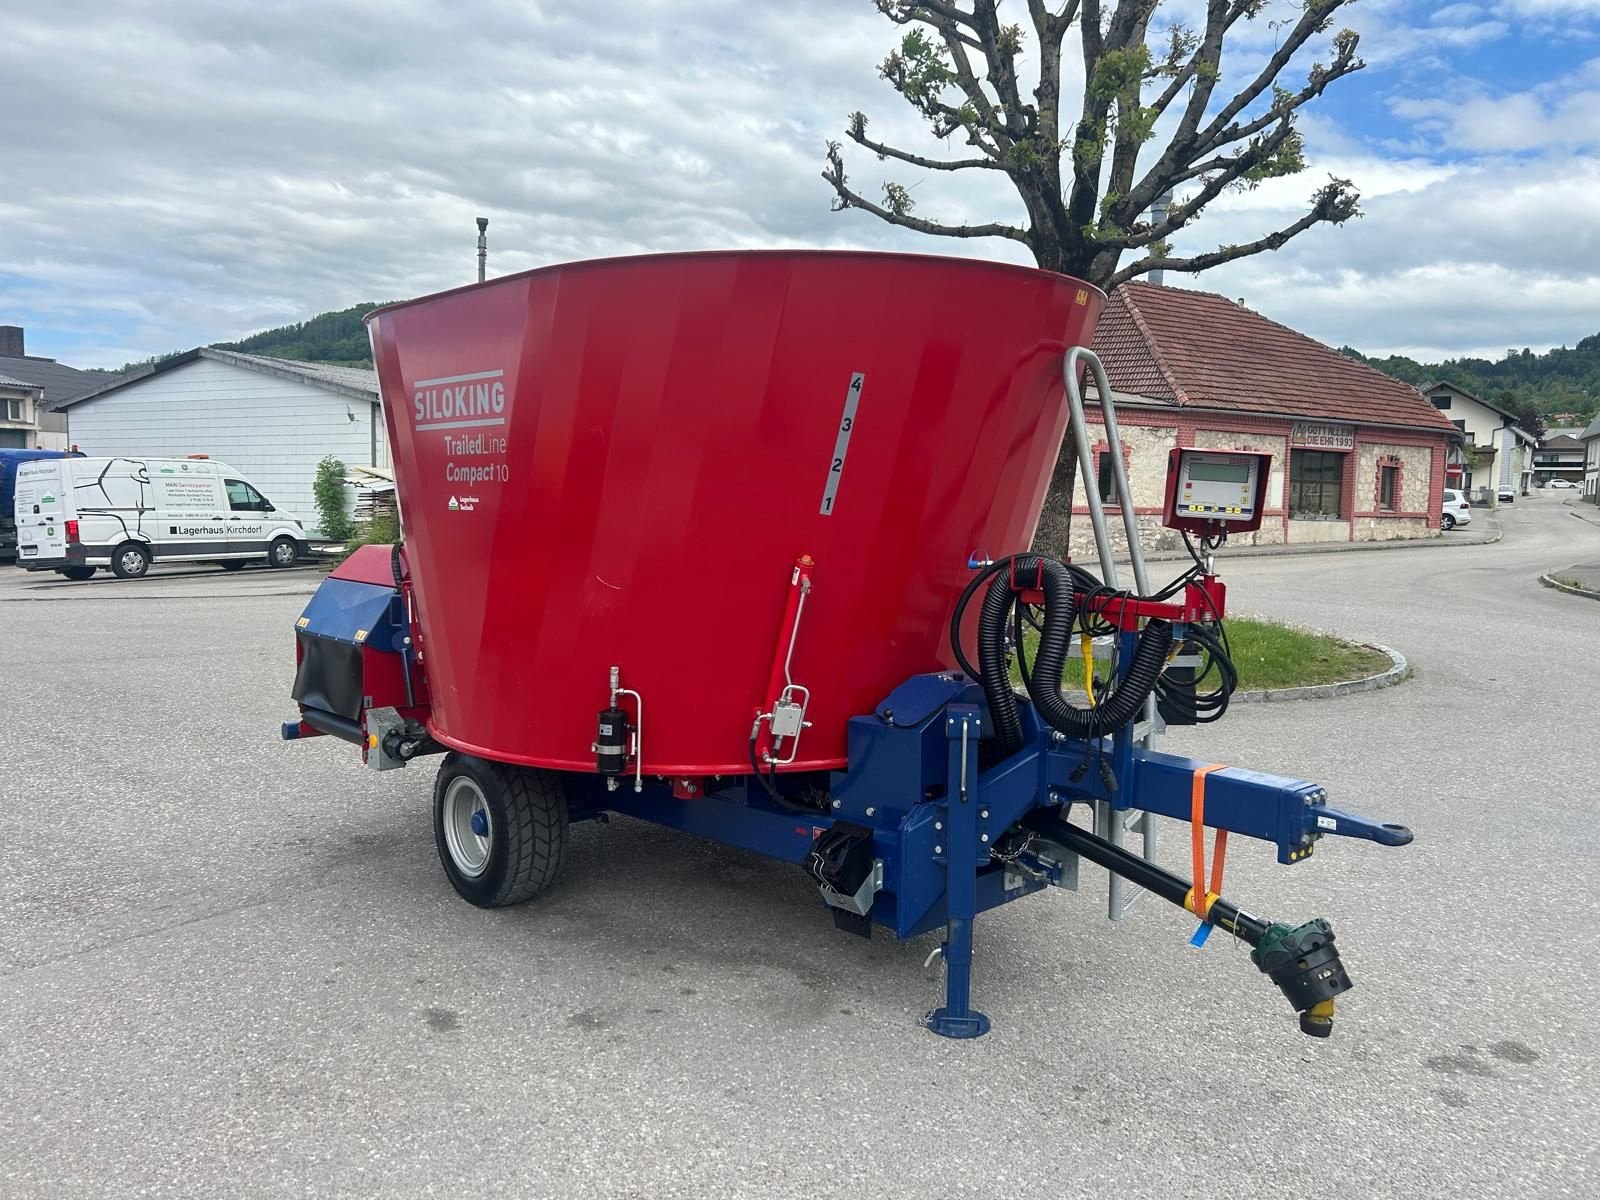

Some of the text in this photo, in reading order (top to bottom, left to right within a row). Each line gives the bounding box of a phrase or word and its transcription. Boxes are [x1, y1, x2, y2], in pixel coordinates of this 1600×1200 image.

[851, 377, 861, 392] 4
[414, 381, 504, 421] SILOKING
[841, 417, 852, 432] 3
[1307, 425, 1353, 437] GOTT ALLEIN
[444, 433, 507, 456] TrailedLine
[1307, 436, 1353, 447] DIE EHR 1993
[832, 457, 842, 472] 2
[446, 462, 509, 487] Compact 10
[825, 497, 832, 511] 1
[178, 525, 262, 536] Lagerhaus Kirchdorf
